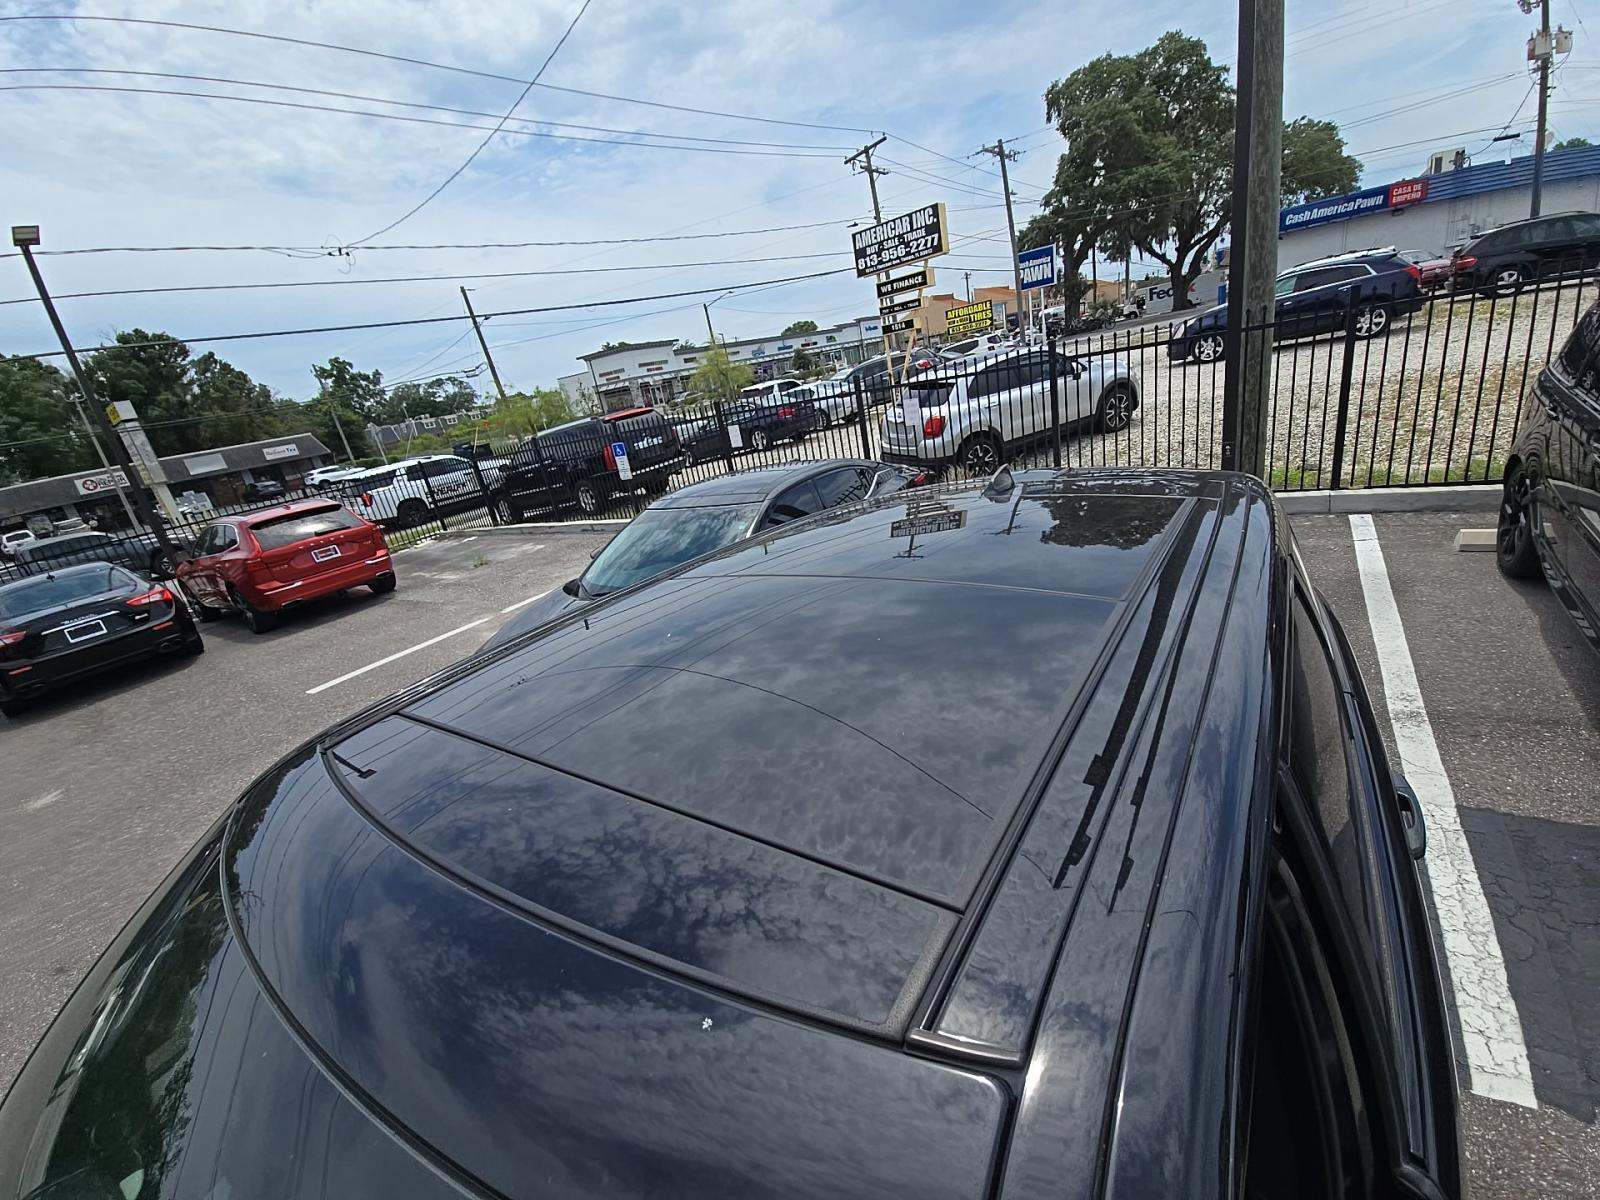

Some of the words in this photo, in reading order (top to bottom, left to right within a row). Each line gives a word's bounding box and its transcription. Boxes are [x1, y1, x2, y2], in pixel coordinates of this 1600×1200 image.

[1393, 185, 1412, 196] CASA
[1413, 183, 1423, 191] DE
[855, 215, 911, 250] AMERICAR
[911, 206, 937, 230] INC.
[866, 244, 880, 255] BUY
[883, 238, 899, 249] SALE
[903, 228, 926, 243] TRADE
[857, 233, 939, 269] 813-956-2277
[880, 284, 892, 293] WE
[893, 275, 923, 290] FINANCE
[947, 301, 991, 319] AFFORDABLE
[970, 310, 992, 322] TIRES
